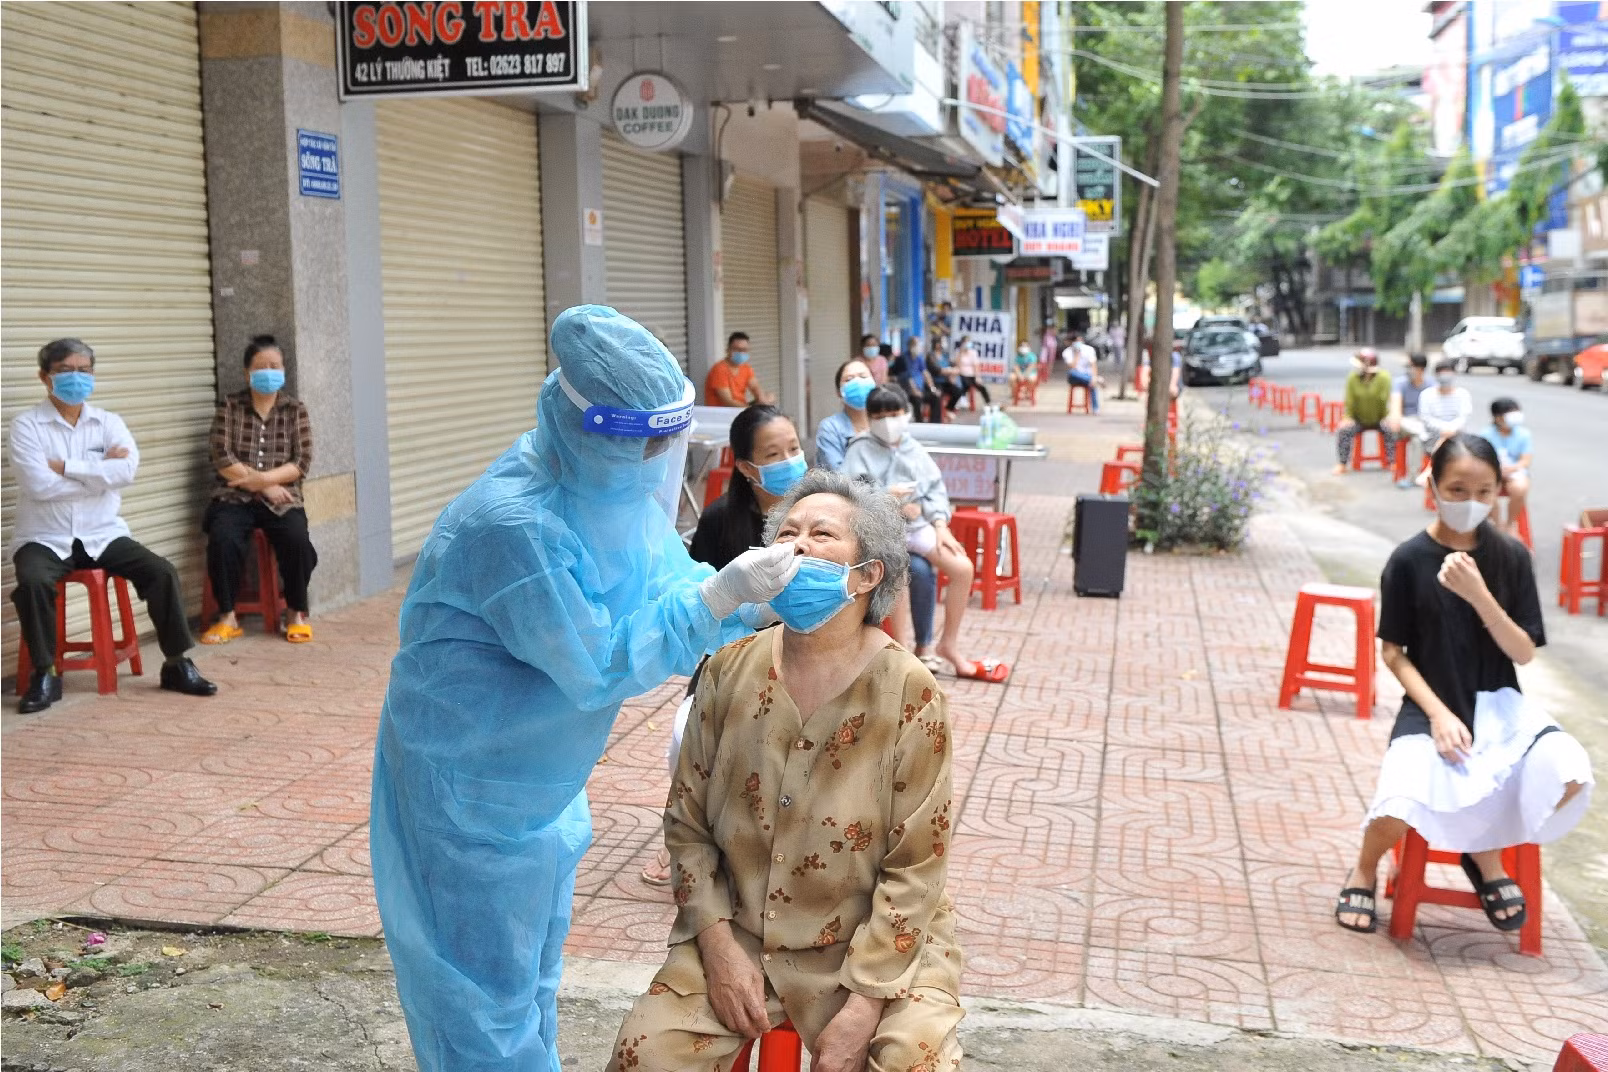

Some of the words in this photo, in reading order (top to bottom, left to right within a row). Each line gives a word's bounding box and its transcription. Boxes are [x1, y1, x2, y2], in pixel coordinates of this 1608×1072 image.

[354, 61, 369, 82] 42
[465, 56, 489, 77] TEL:
[524, 52, 543, 75] 817
[545, 52, 566, 73] 897
[623, 121, 673, 134] COFFEE
[656, 415, 682, 426] Face
